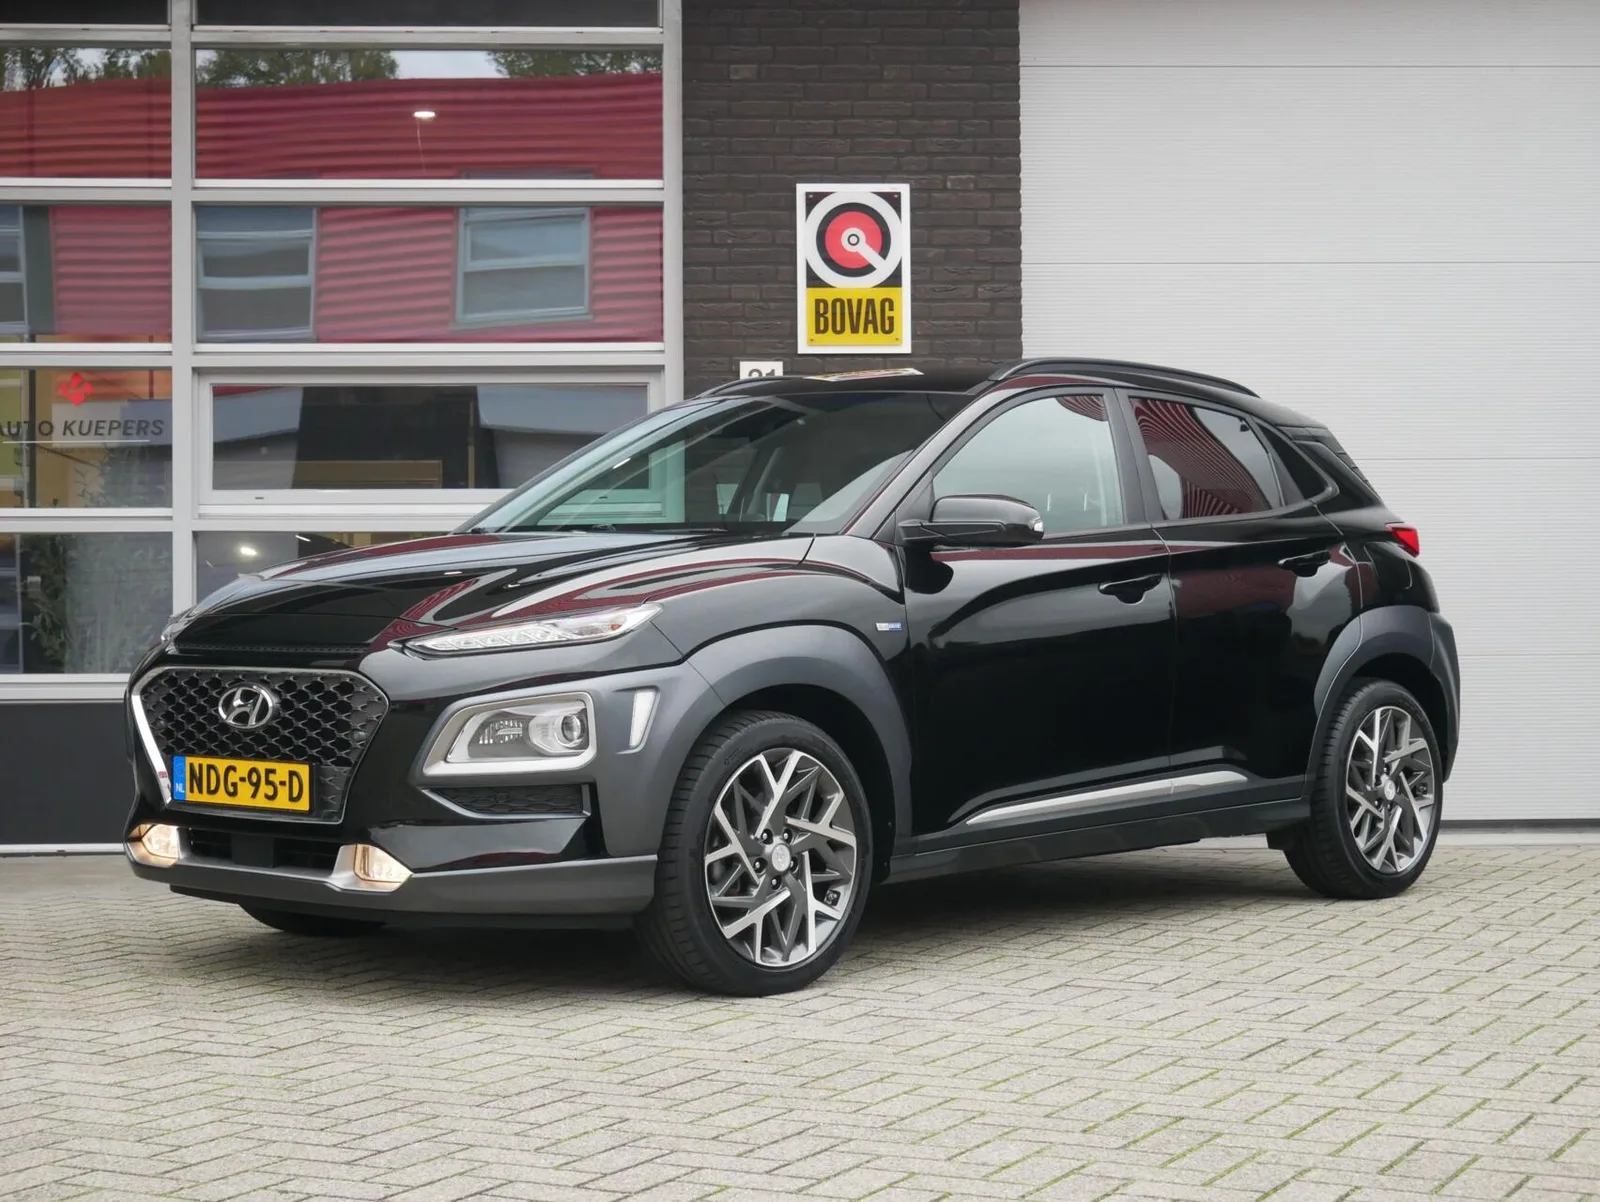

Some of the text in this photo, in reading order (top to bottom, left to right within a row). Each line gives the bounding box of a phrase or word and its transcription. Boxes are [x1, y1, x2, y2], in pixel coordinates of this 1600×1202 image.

[814, 297, 895, 335] BOVAG
[0, 419, 165, 437] UTO KUEPERS
[175, 782, 185, 794] NL
[188, 761, 304, 803] NDG-95-D
